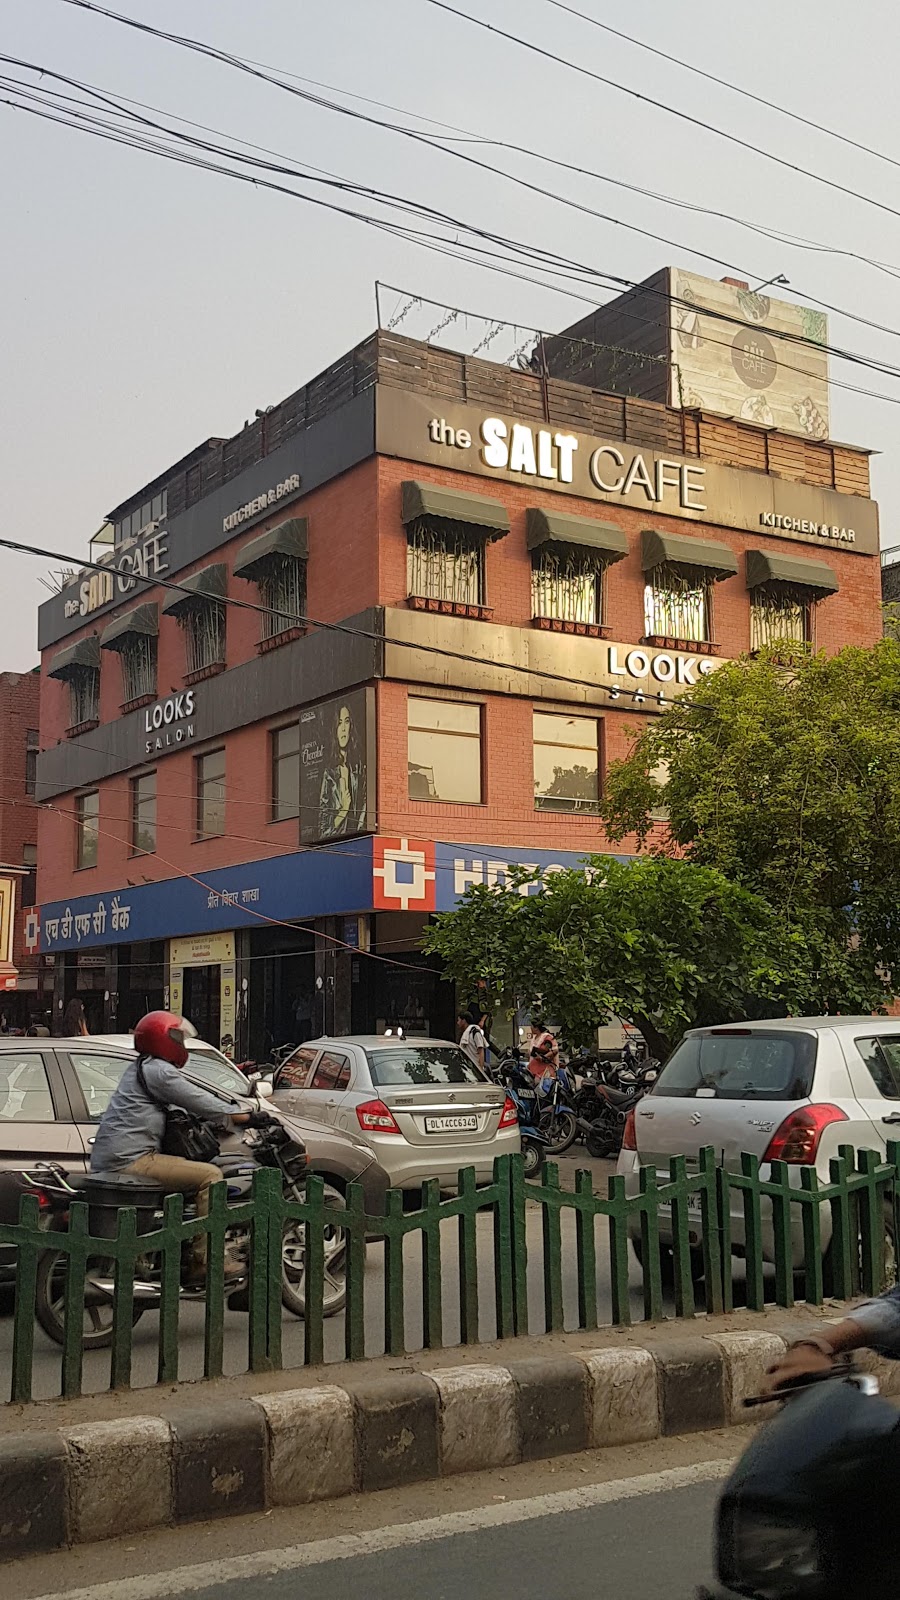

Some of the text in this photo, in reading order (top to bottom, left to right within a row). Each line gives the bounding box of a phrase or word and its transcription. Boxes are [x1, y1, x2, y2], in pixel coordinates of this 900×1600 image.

[429, 417, 708, 512] the SALT CAFE
[223, 474, 300, 532] KITCHEN & BAR
[760, 511, 856, 542] KITCHEN & BAR
[64, 600, 80, 618] the
[117, 531, 169, 593] CAFE
[145, 690, 195, 733] LOOKS
[145, 724, 195, 753] SALON
[431, 1115, 476, 1129] DL14CC6349
